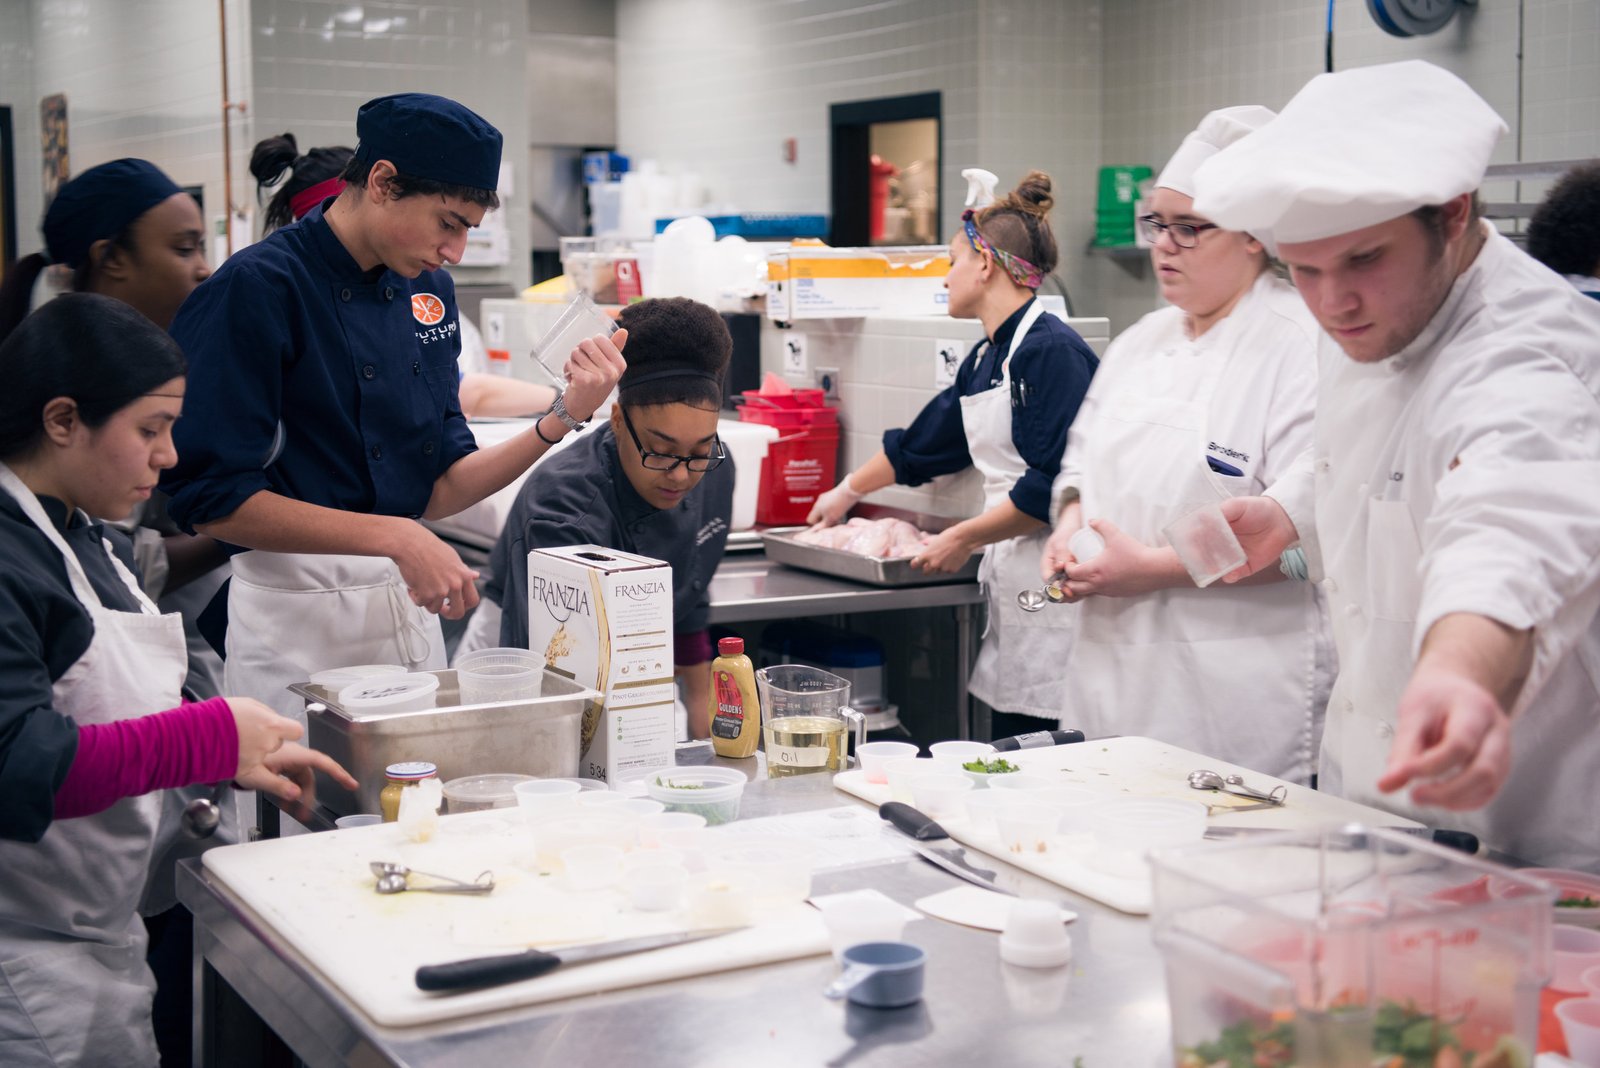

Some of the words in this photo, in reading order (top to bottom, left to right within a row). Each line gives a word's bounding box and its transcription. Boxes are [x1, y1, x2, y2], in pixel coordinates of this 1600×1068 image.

[533, 575, 590, 621] FRANZIA
[615, 582, 666, 600] FRANZIA
[718, 702, 743, 715] GULDEN'S
[781, 751, 799, 764] Oil
